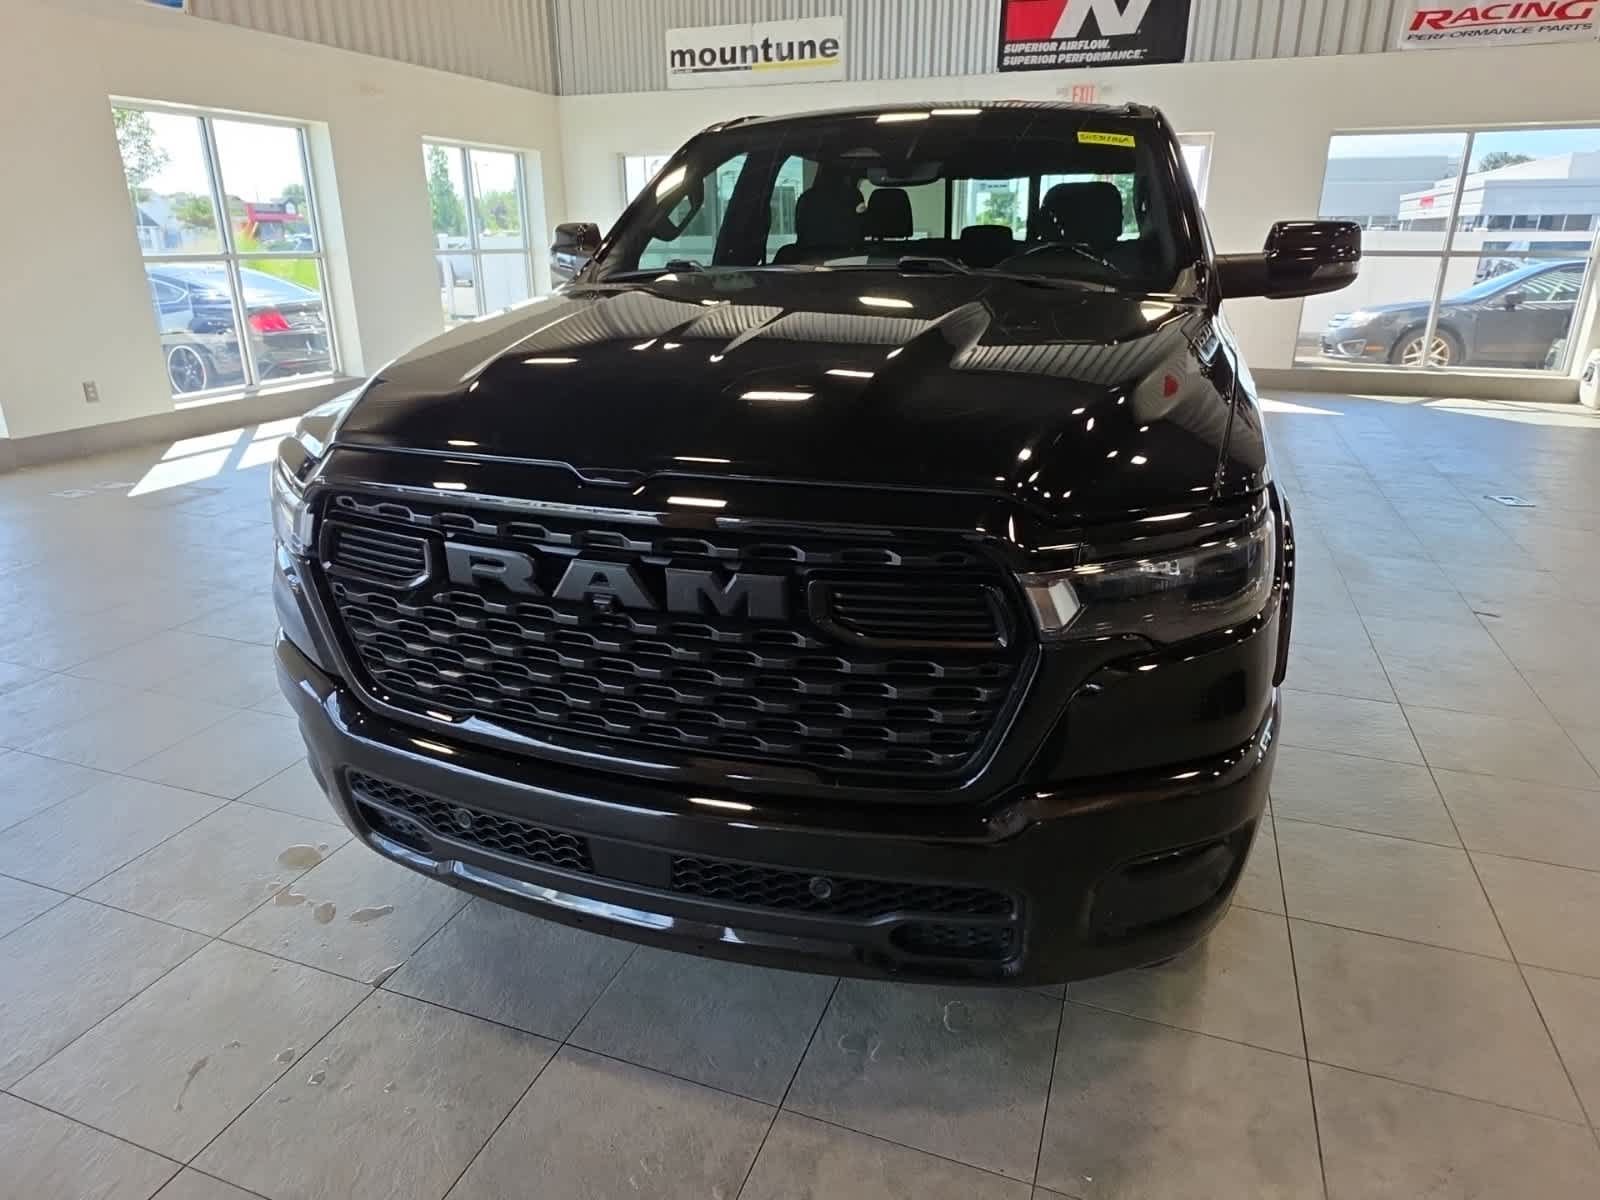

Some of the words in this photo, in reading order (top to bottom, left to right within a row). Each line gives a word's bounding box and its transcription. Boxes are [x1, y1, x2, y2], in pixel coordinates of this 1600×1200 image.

[1409, 0, 1599, 31] RACING
[1407, 26, 1534, 41] PERFORMANCE
[1538, 22, 1593, 33] PARTS
[670, 37, 840, 68] mountune
[1004, 41, 1058, 54] SUPERIOR
[1059, 39, 1110, 51] AIRFLOW.
[1003, 53, 1057, 66] SUPERIOR
[444, 541, 786, 618] RAM
